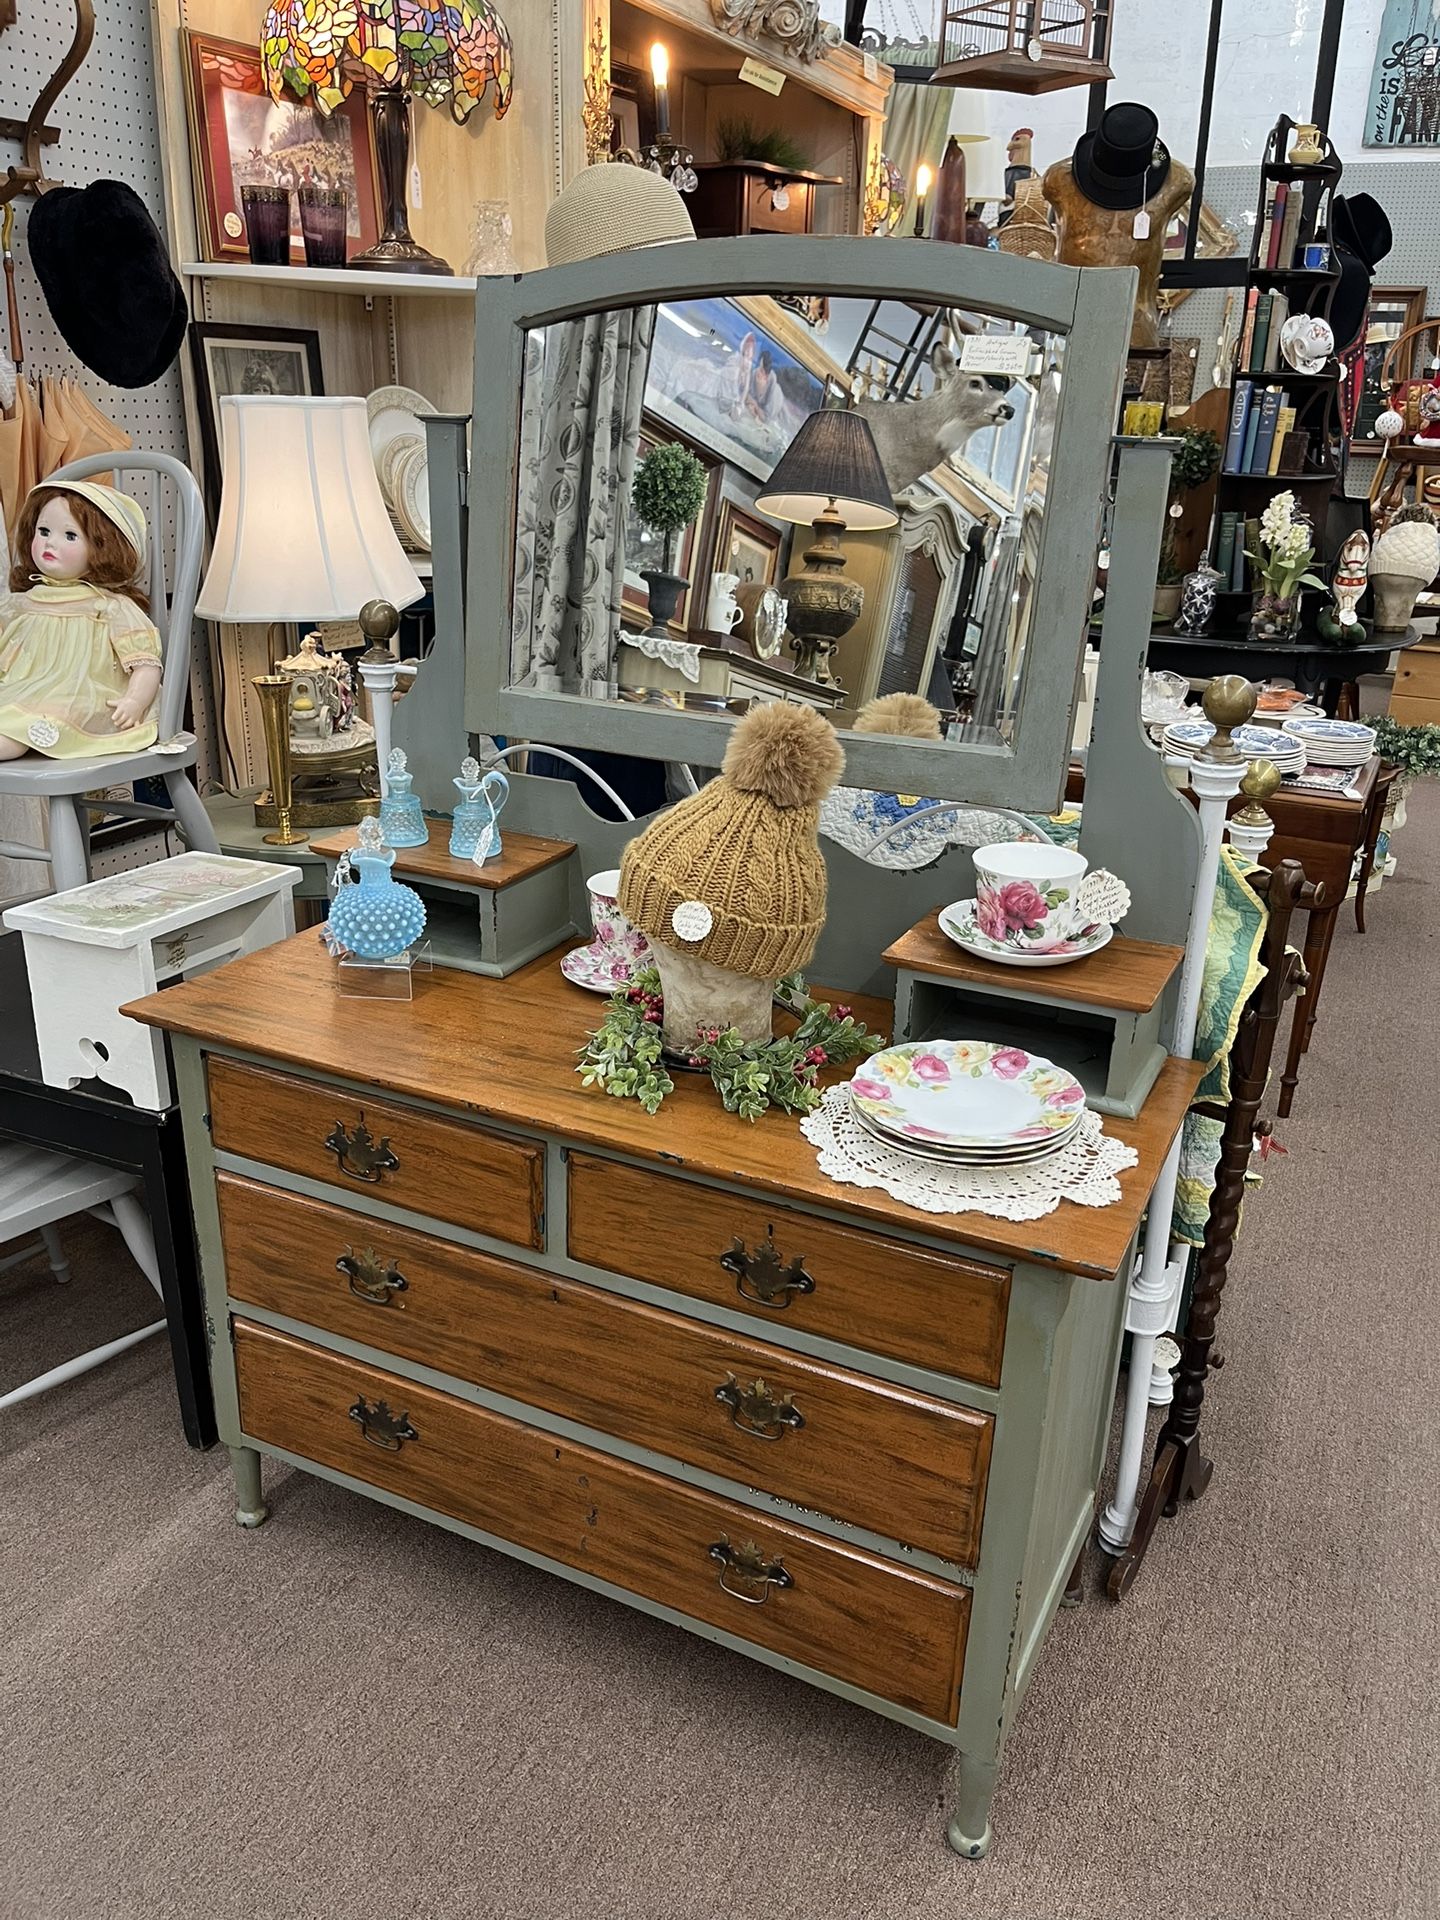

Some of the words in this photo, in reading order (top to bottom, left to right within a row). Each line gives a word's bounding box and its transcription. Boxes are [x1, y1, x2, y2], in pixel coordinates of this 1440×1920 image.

[1379, 72, 1401, 95] is
[1375, 95, 1391, 121] the
[1374, 123, 1385, 143] on
